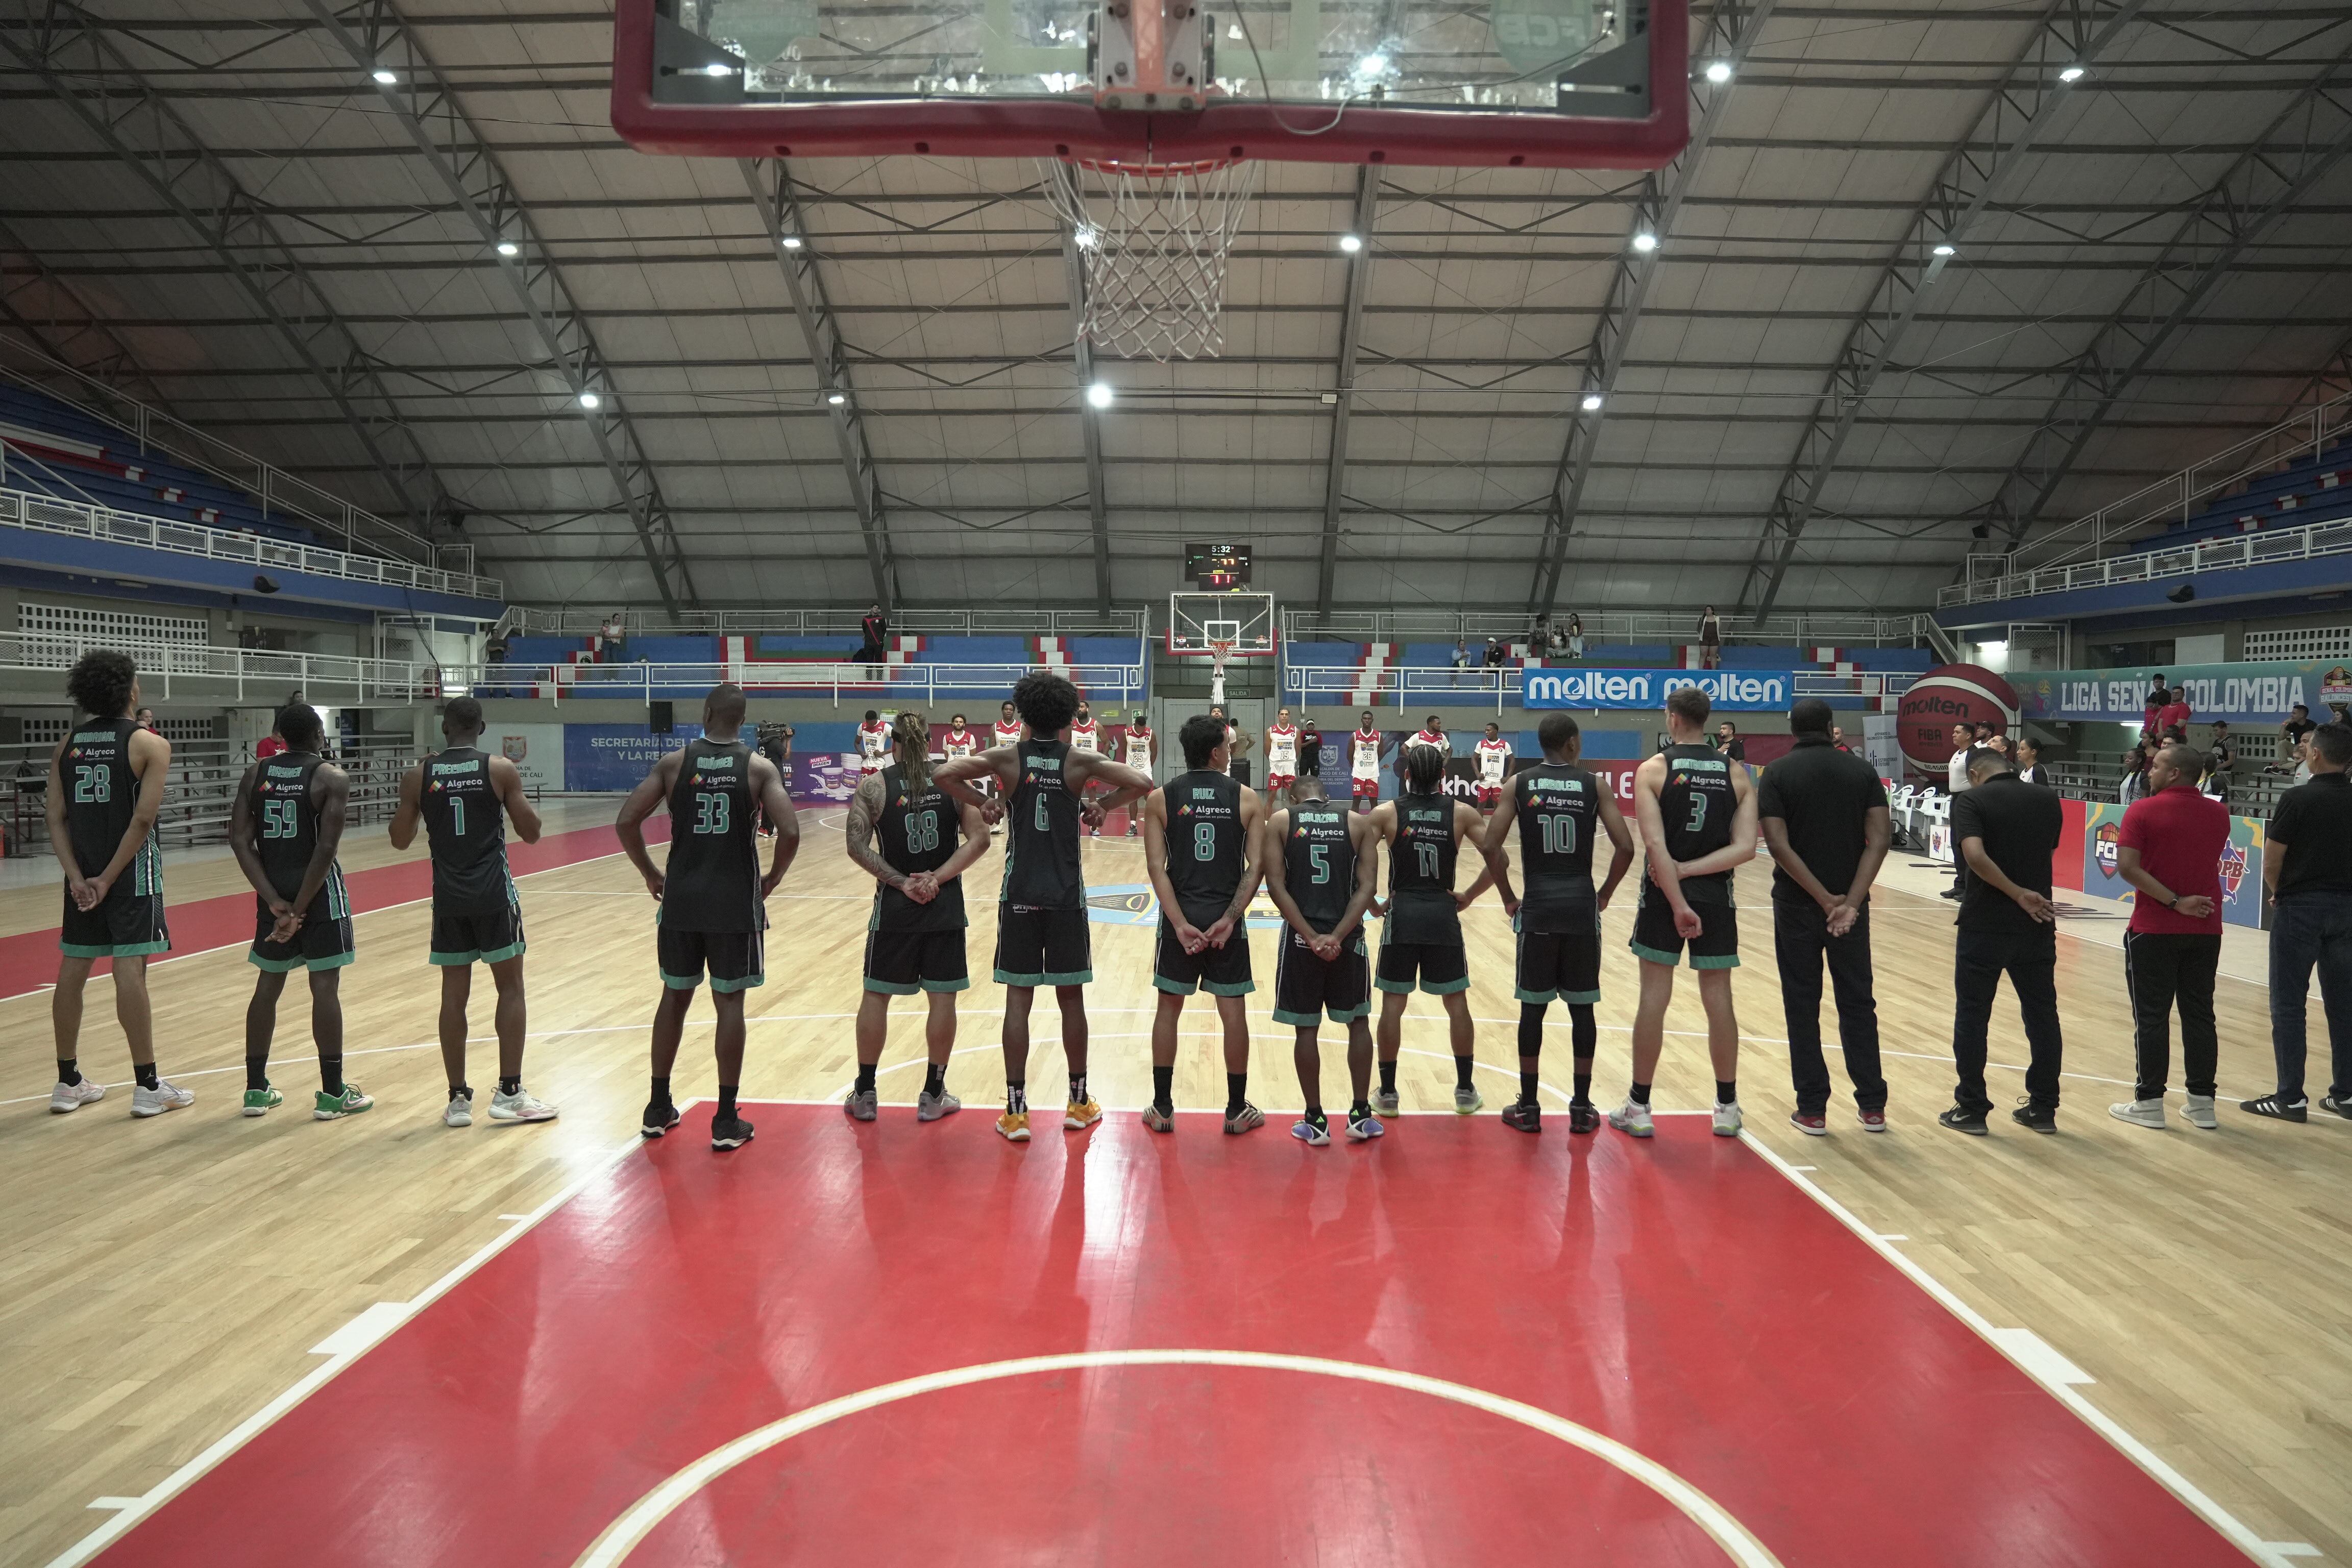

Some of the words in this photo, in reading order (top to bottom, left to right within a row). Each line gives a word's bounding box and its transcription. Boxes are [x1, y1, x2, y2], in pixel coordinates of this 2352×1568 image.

[2061, 682, 2101, 712] LIGA
[2183, 676, 2305, 713] COLOMBIA
[1903, 696, 1969, 718] molten
[74, 731, 116, 743] MADRIGAL
[1918, 729, 1942, 741] FIBA
[665, 738, 689, 747] DEL
[85, 748, 115, 757] Algreco
[628, 751, 643, 760] LA
[1133, 753, 1143, 762] 25
[1280, 751, 1289, 760] 15
[1363, 752, 1371, 760] 26
[432, 760, 479, 775] PRECIADO
[1490, 763, 1494, 771] 1
[76, 765, 110, 802] 28
[447, 779, 483, 788] Algreco
[707, 776, 737, 785] Algreco
[1528, 779, 1536, 790] S.
[1538, 778, 1582, 792] ARBOLEDA
[1691, 776, 1726, 785] Algreco
[276, 783, 303, 792] Algreco
[1193, 788, 1215, 799] RUIZ
[1546, 796, 1583, 806] Algreco
[693, 793, 729, 834] 33
[1035, 792, 1049, 831] 6
[1195, 805, 1231, 815] Algreco
[1409, 810, 1441, 822] MOJICA
[1685, 792, 1707, 831] 3
[264, 800, 297, 838] 59
[450, 797, 465, 836] 1
[1298, 812, 1338, 823] SALAZAR
[905, 810, 939, 853] 88
[1311, 828, 1343, 837] Algreco
[1417, 826, 1448, 836] Algreco
[1537, 814, 1576, 853] 10
[1194, 823, 1215, 861] 8
[1310, 845, 1329, 884] 5
[1414, 842, 1439, 879] 11
